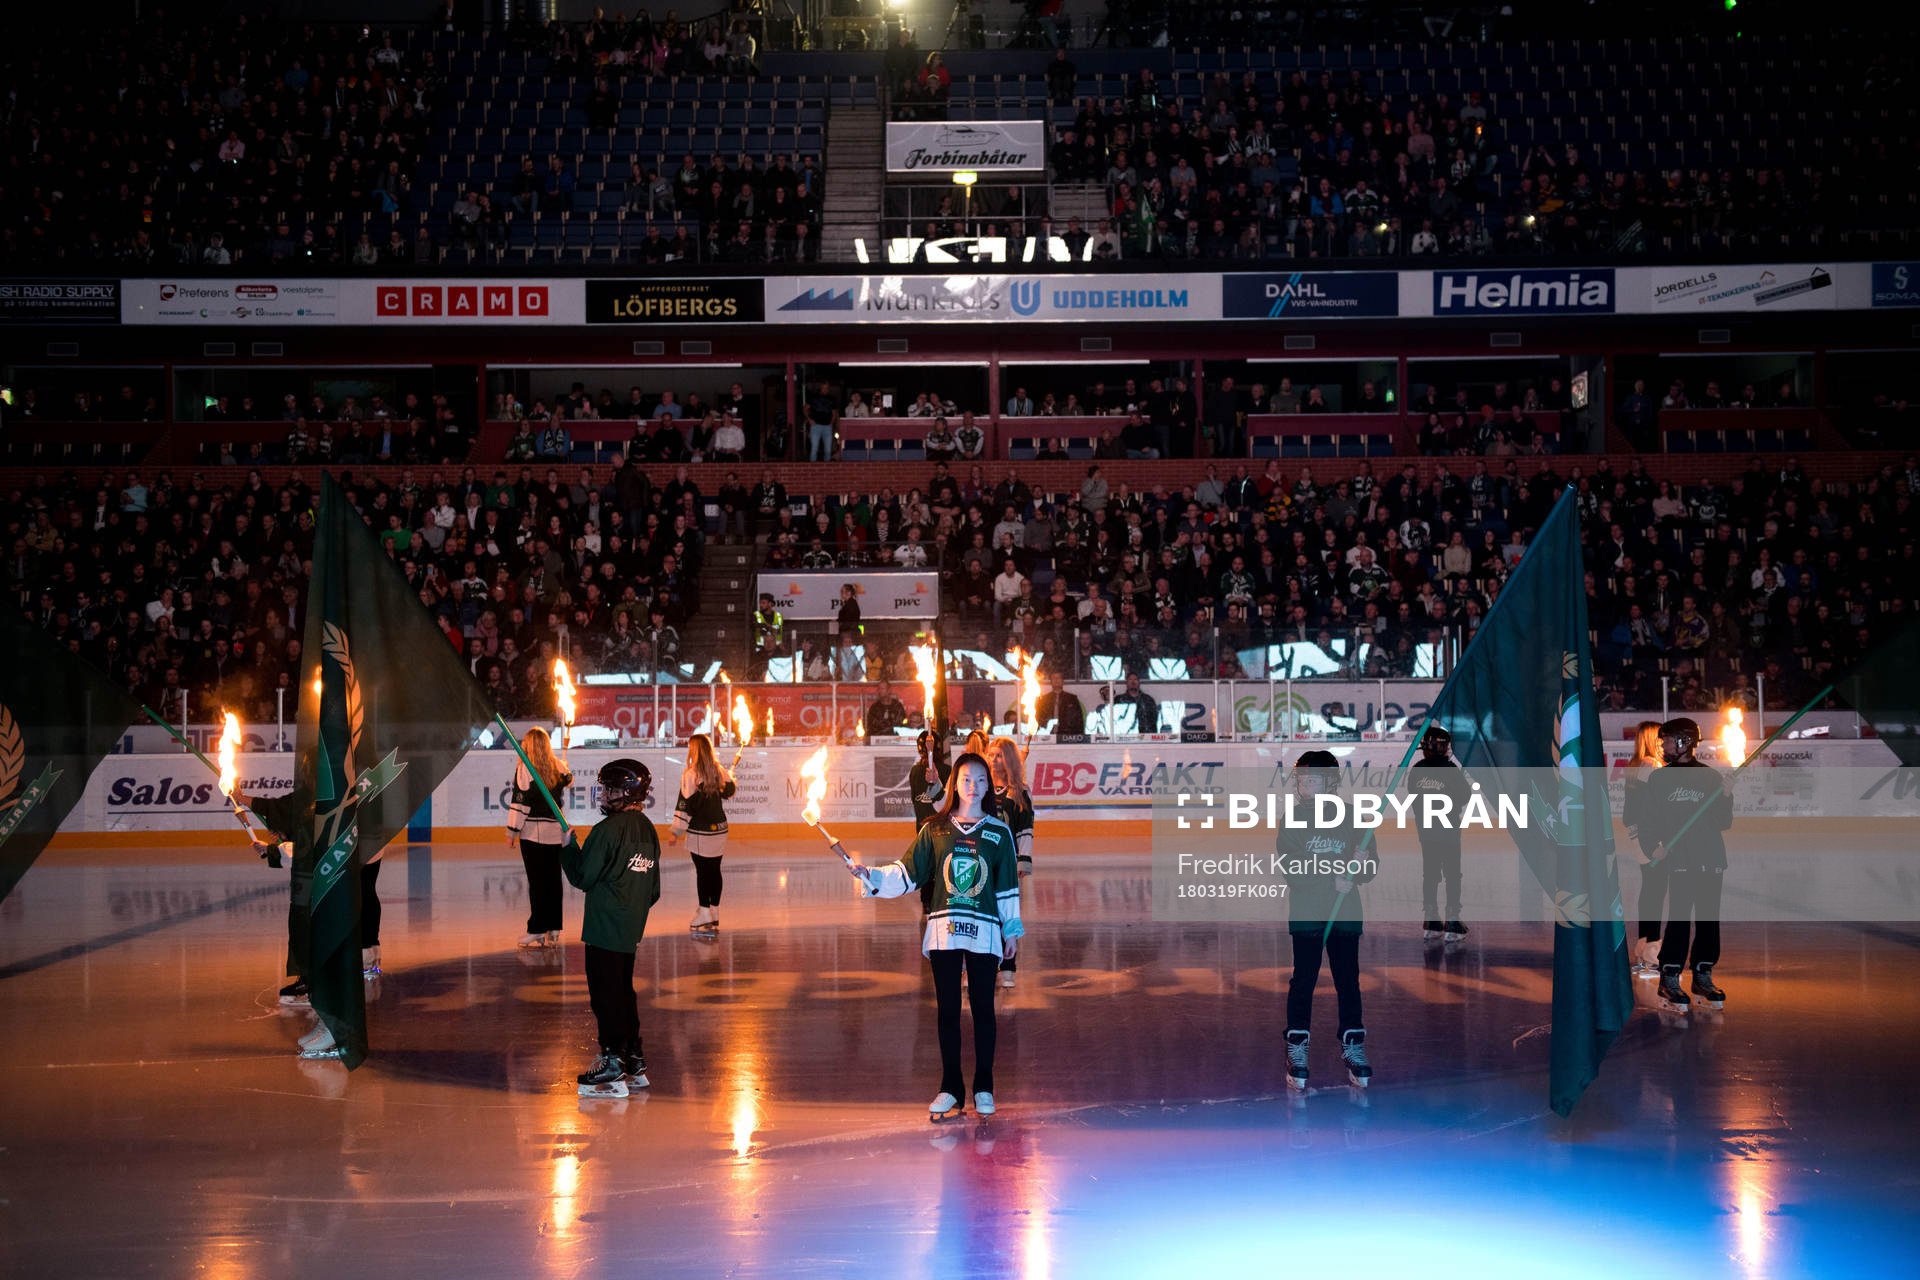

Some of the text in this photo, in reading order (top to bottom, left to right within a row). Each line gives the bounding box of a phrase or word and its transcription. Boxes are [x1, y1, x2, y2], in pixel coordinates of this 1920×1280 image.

[905, 148, 1026, 169] Forbinabåtar
[23, 287, 63, 297] RADIO
[66, 287, 115, 297] SUPPLY
[179, 287, 230, 299] Preferens
[1265, 283, 1326, 298] DAHL
[1440, 274, 1609, 308] Helmia
[1654, 272, 1718, 297] JORDELLS
[384, 292, 542, 311] CRAMO
[614, 296, 738, 317] LÖFBERGS
[1053, 289, 1188, 309] UDDEHOLM
[1032, 762, 1224, 796] LBC FRAKT
[107, 777, 213, 806] Salos
